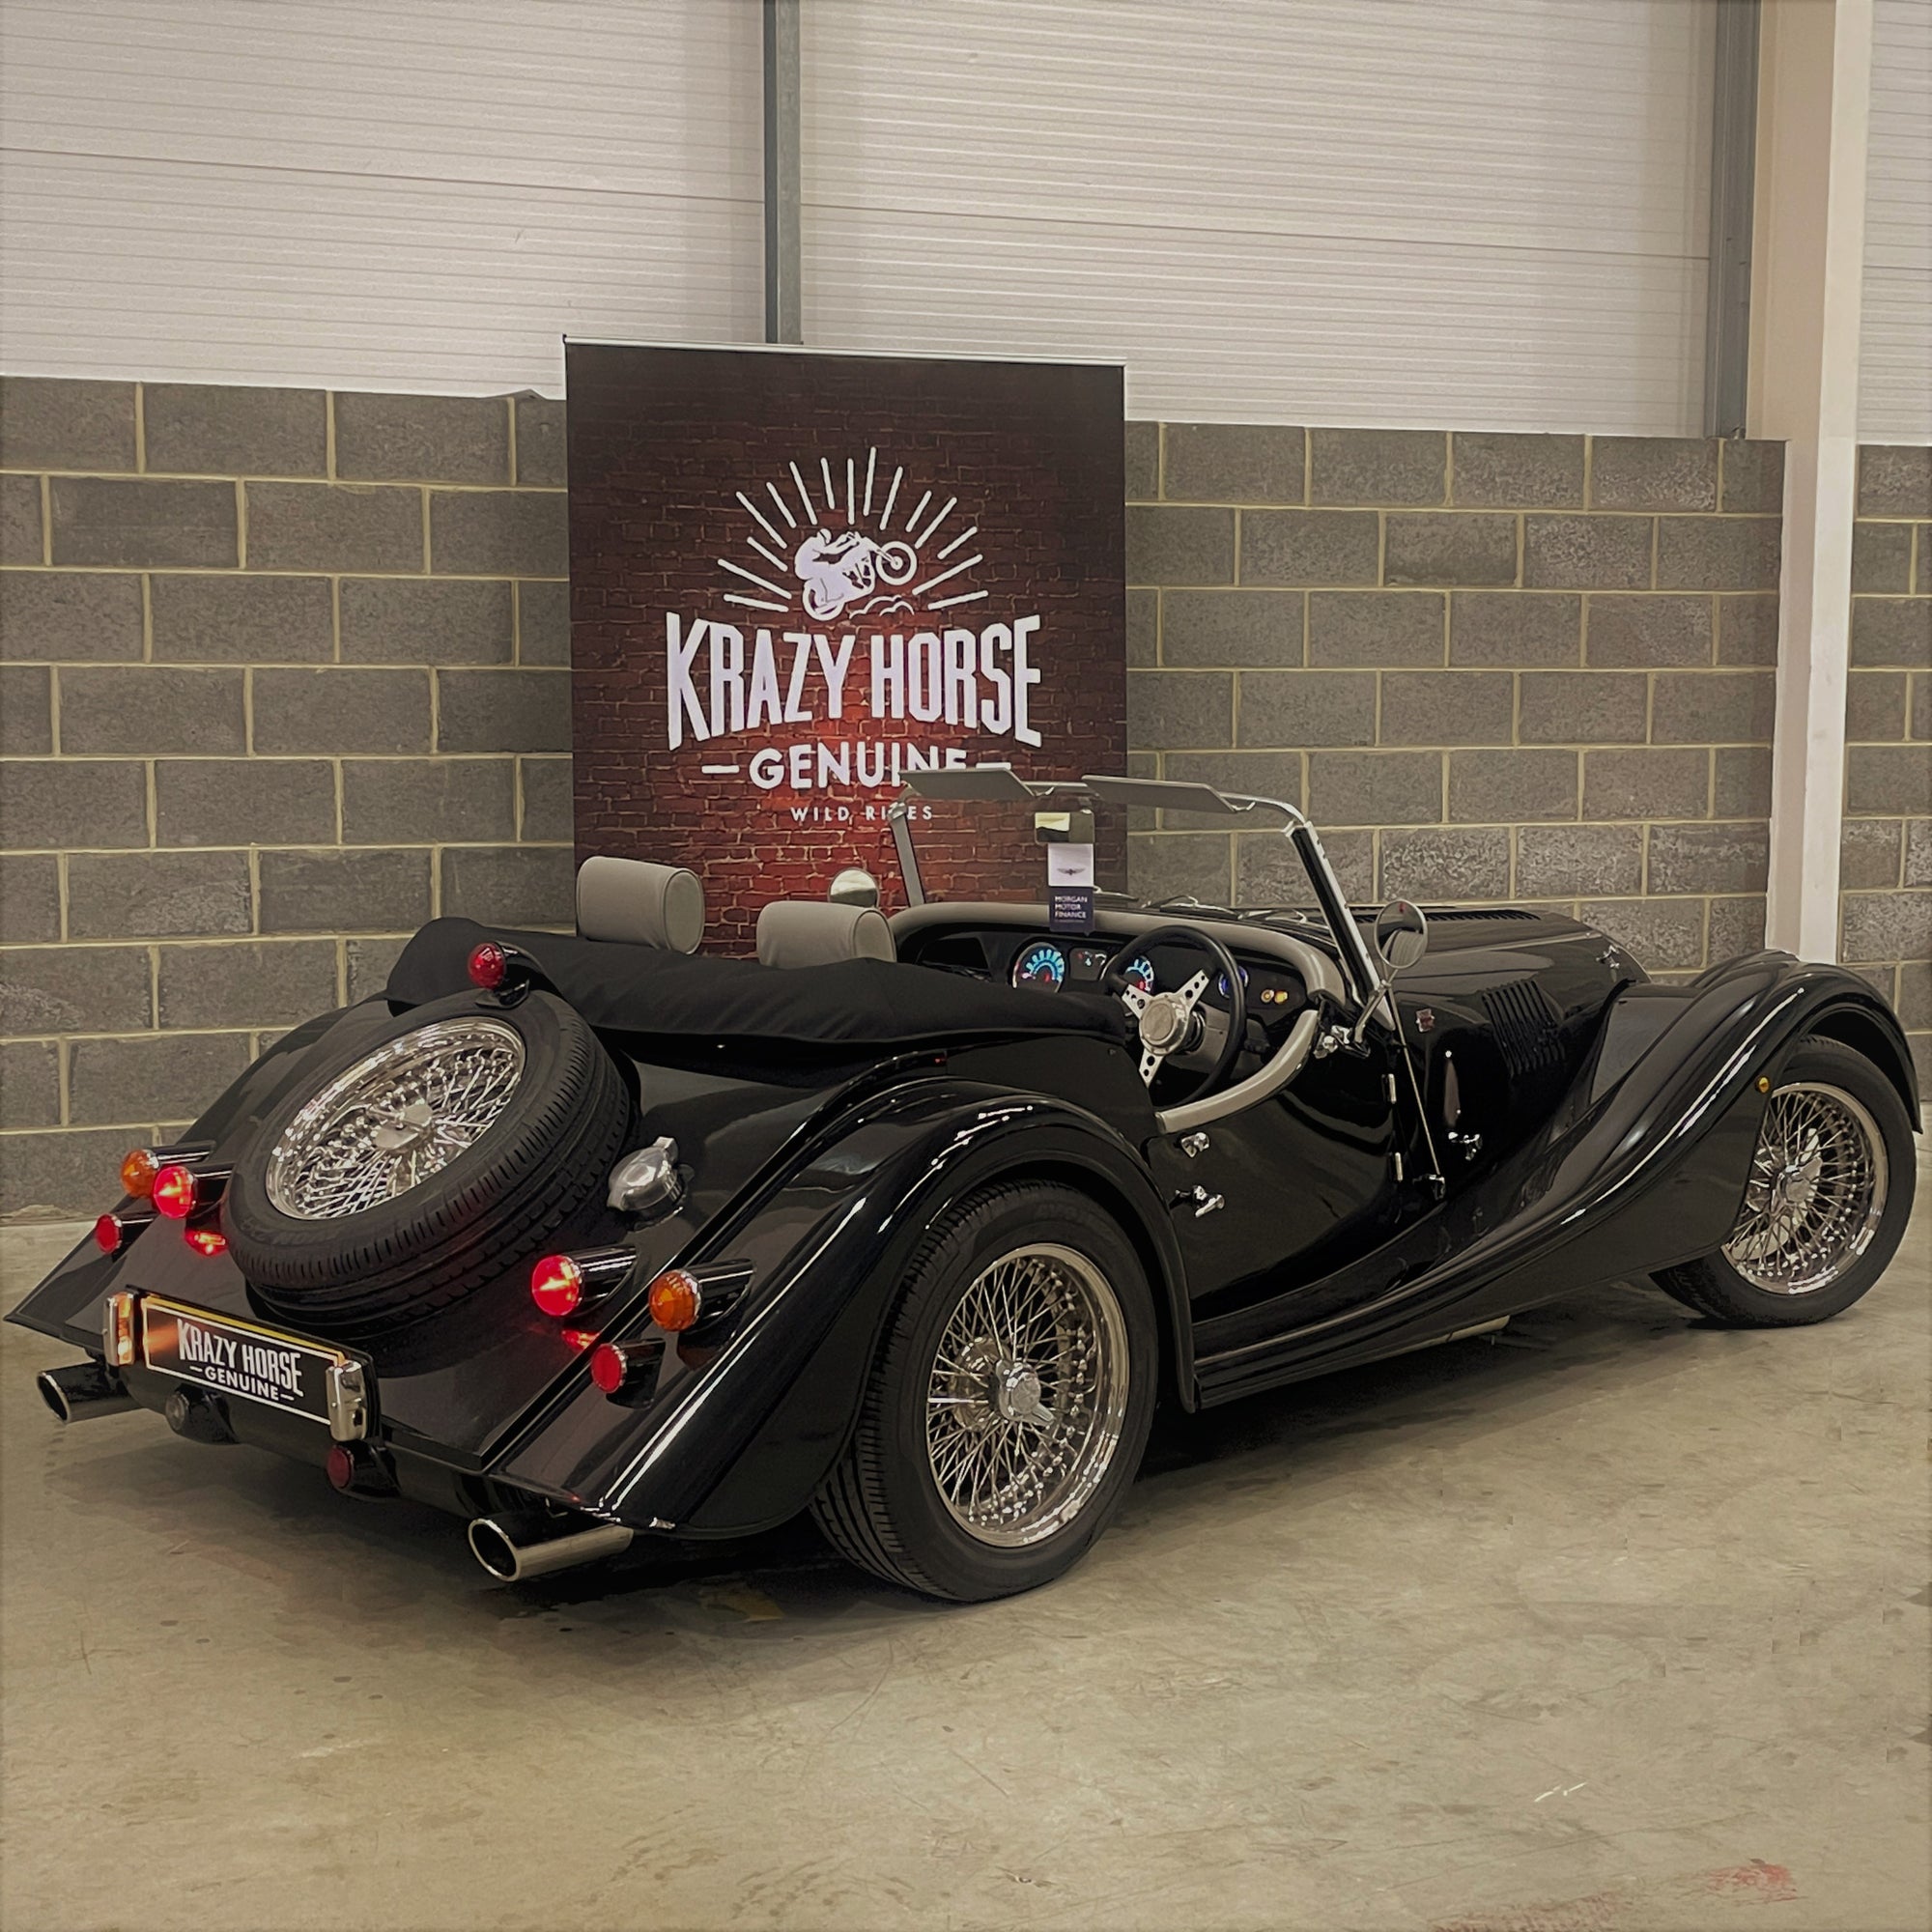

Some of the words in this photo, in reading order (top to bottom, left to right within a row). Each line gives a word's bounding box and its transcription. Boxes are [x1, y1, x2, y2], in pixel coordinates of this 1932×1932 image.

[667, 611, 854, 751] KRAZY
[870, 614, 1041, 748] HORSE
[790, 806, 850, 822] WILD
[865, 805, 933, 821] RIES
[176, 1319, 238, 1370] KRAZY
[242, 1344, 304, 1398] HORSE
[204, 1366, 280, 1401] GENUINE
